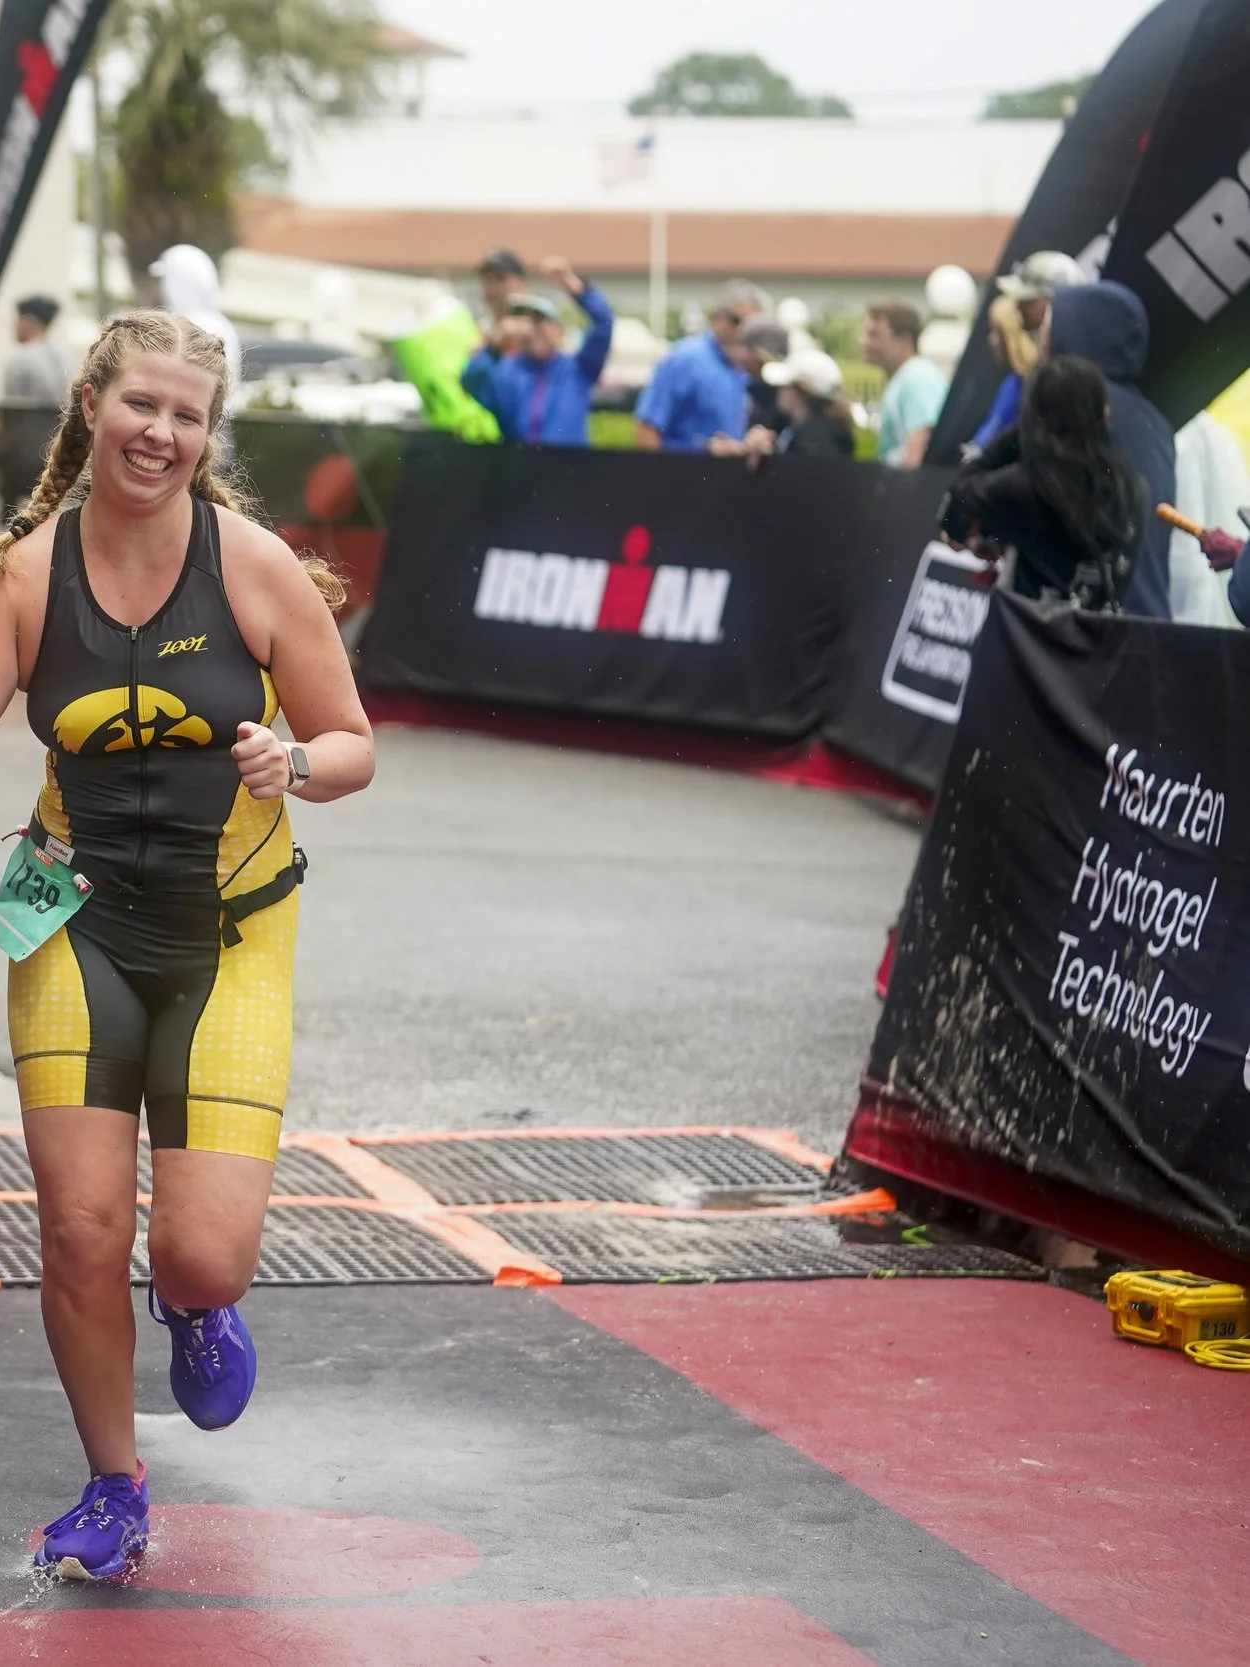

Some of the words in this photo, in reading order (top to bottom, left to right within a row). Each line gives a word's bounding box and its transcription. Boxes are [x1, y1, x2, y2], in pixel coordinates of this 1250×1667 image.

[473, 523, 732, 645] IRONMAN
[1099, 743, 1226, 848] Maurten
[1071, 836, 1218, 957] Hydrogel
[1048, 931, 1213, 1078] Technology
